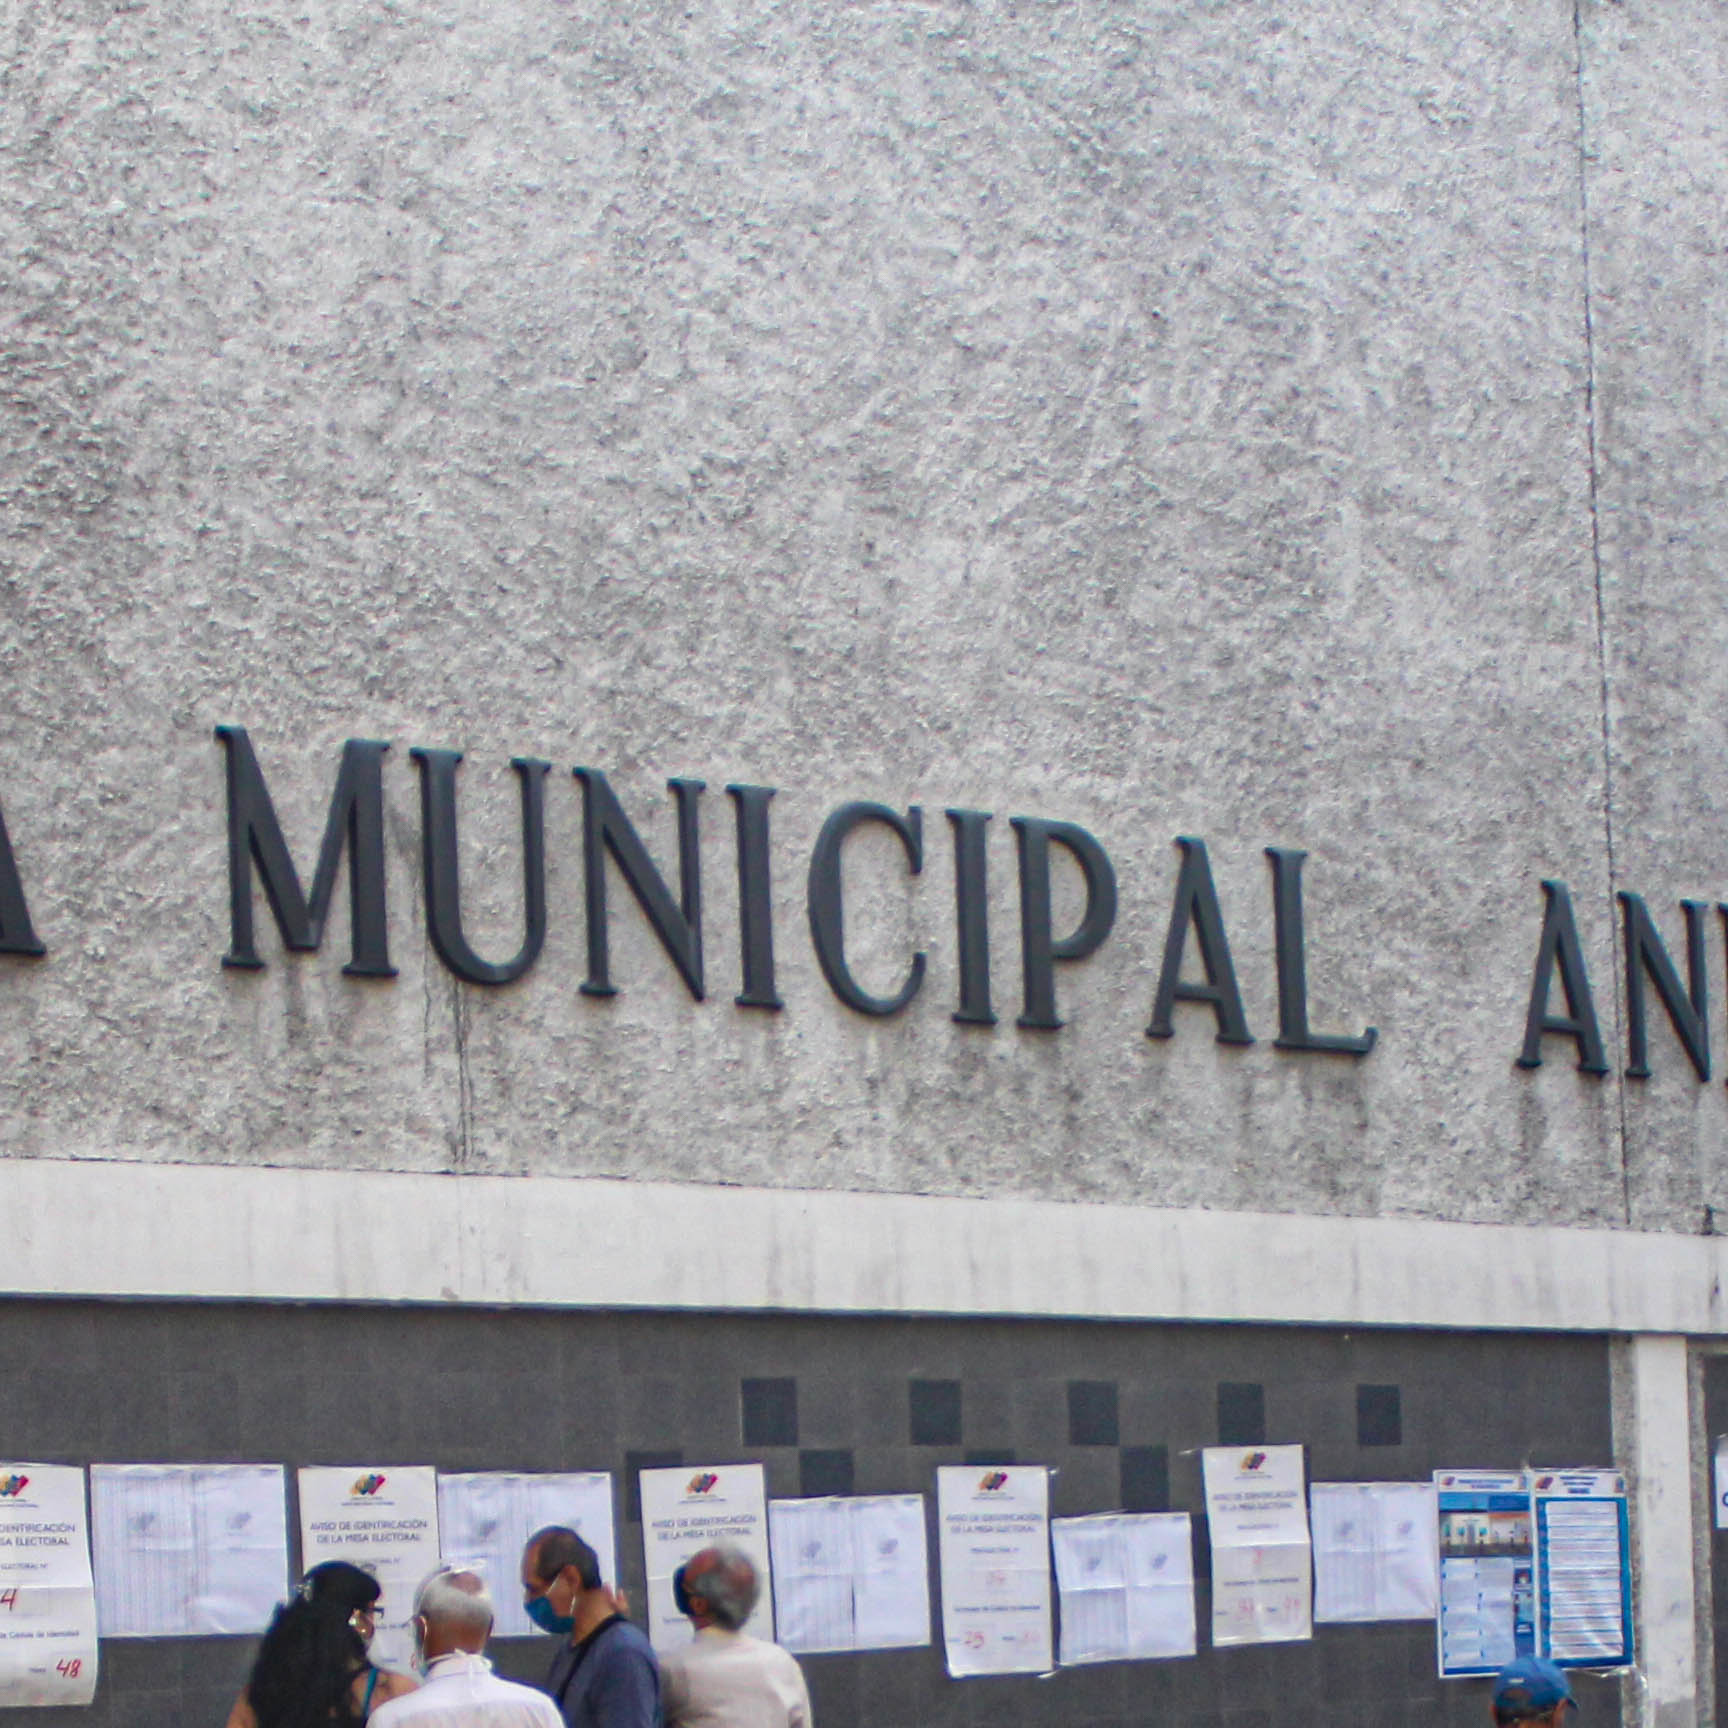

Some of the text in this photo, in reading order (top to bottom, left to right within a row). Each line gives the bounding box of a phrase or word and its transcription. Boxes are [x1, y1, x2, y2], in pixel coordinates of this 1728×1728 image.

[214, 724, 1379, 1055] MUNICIPAL
[0, 1587, 19, 1612] 4
[56, 1658, 82, 1679] 48
